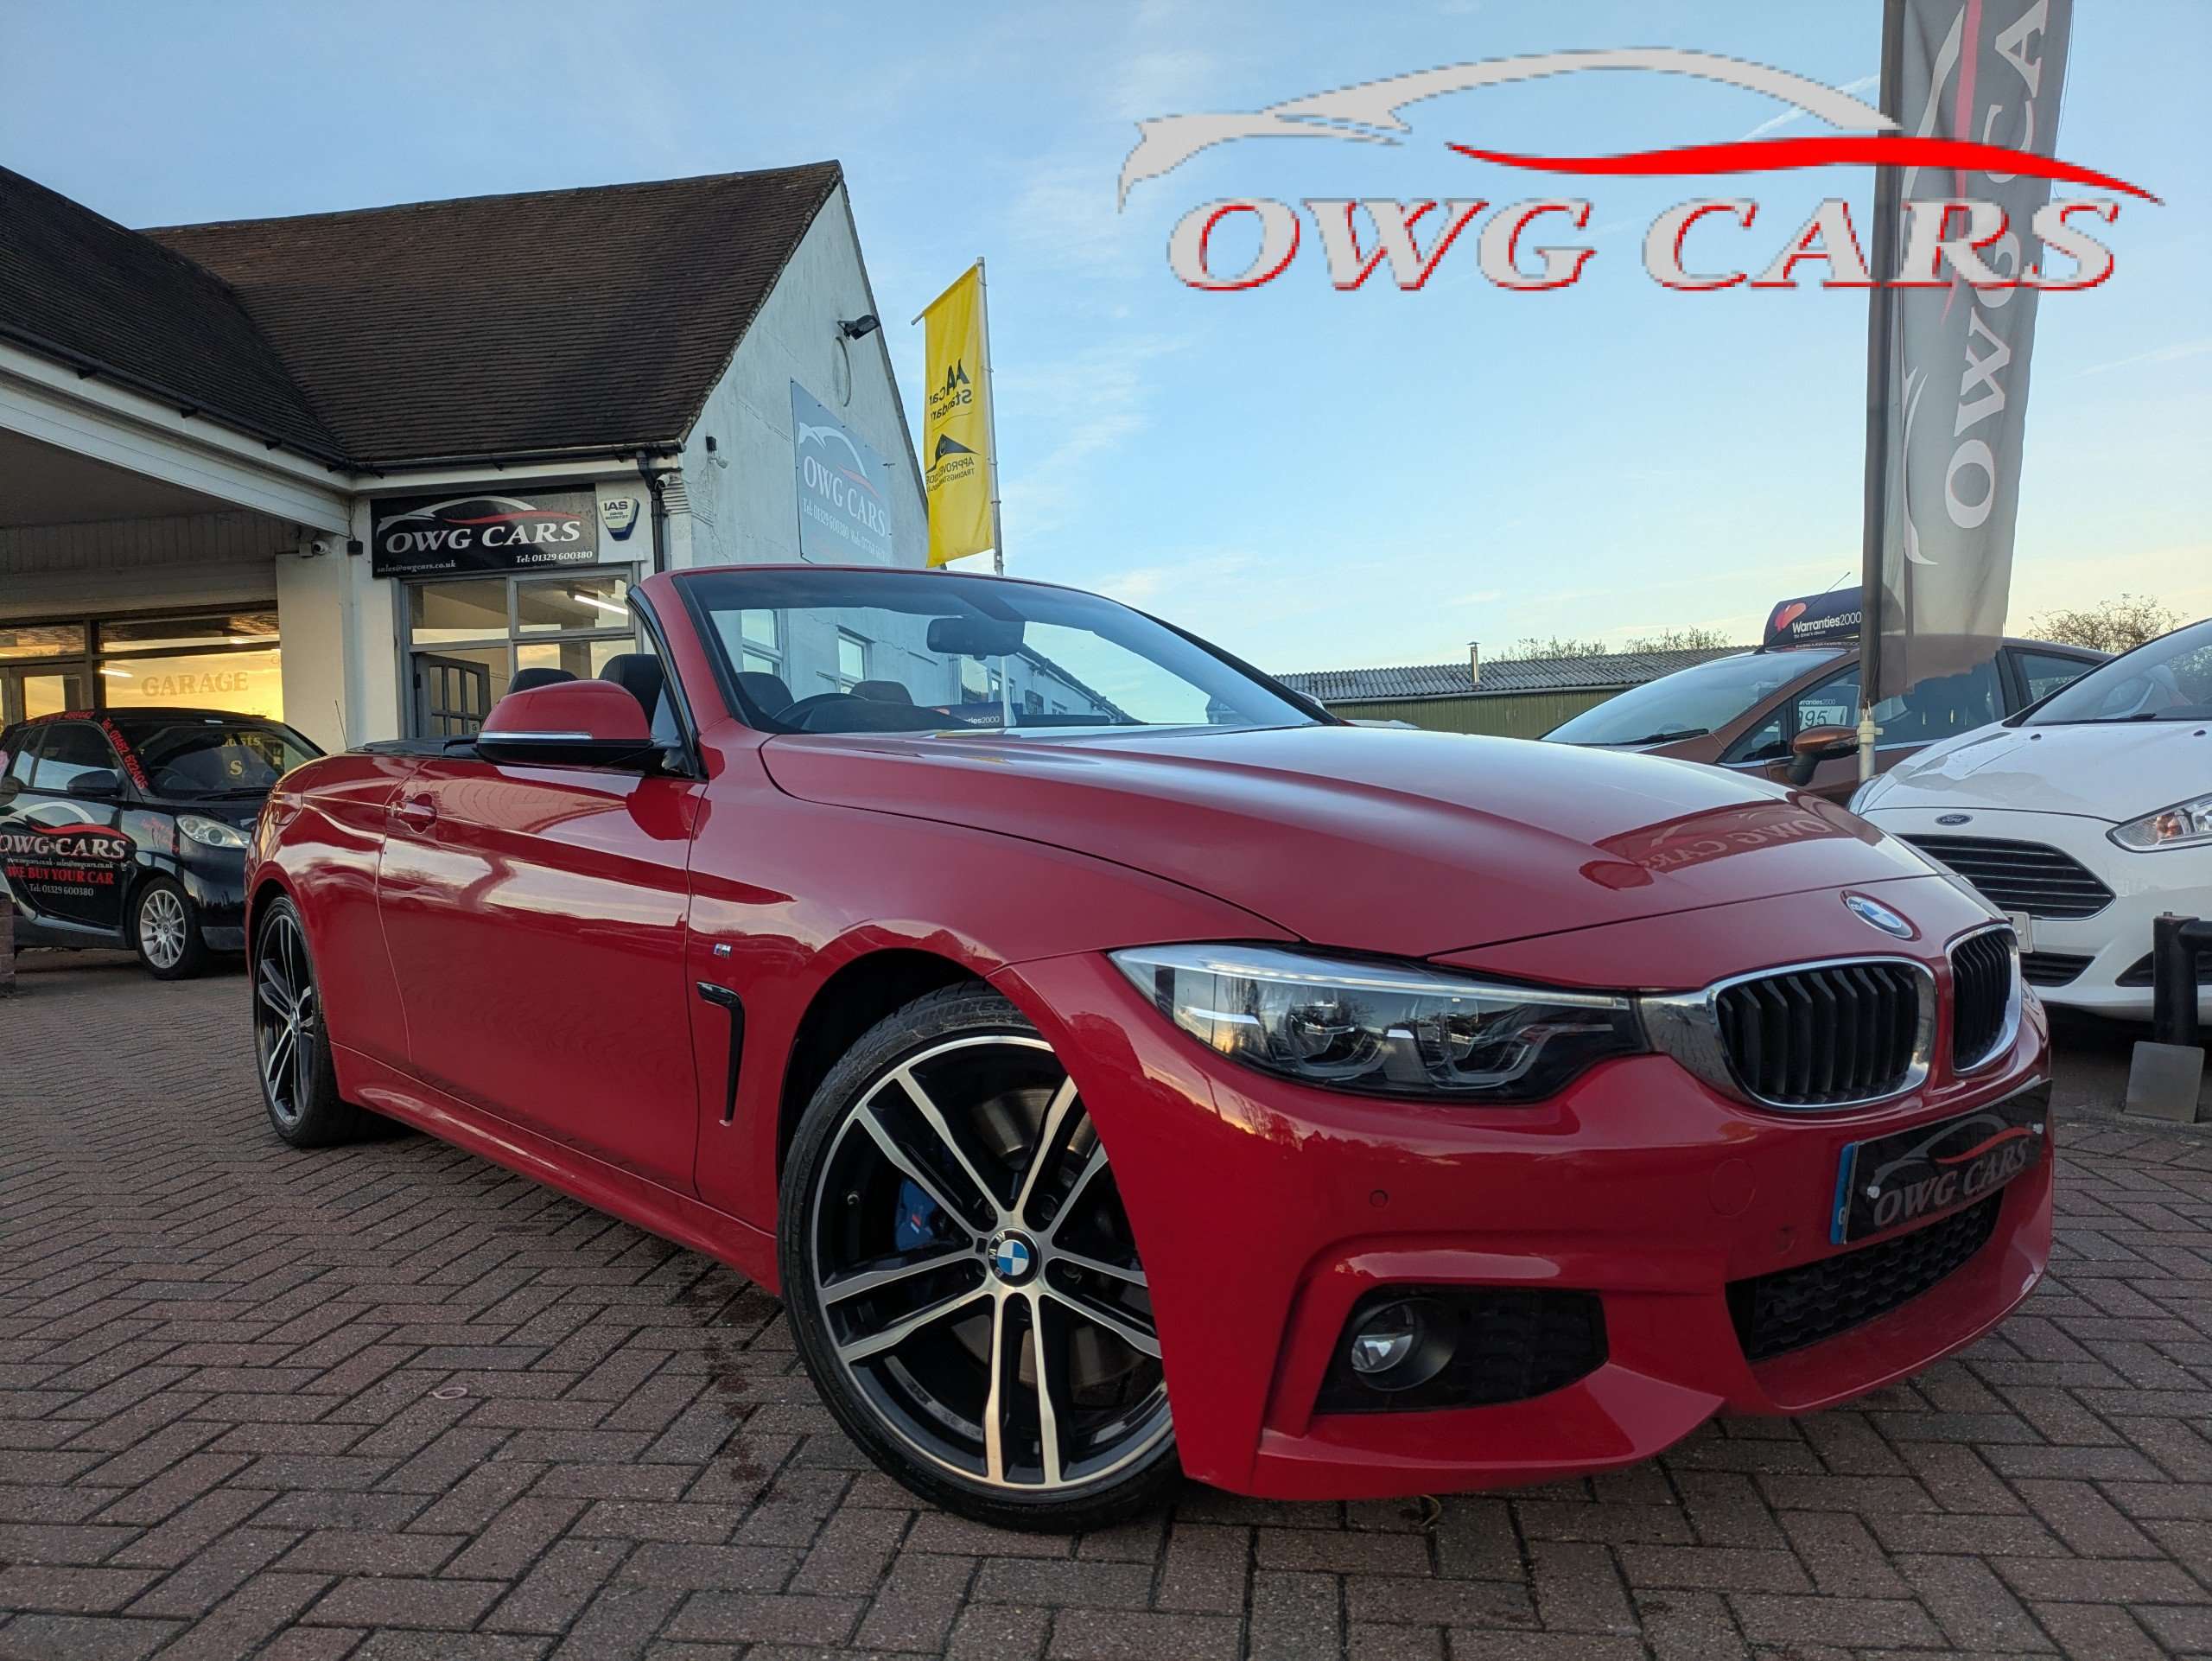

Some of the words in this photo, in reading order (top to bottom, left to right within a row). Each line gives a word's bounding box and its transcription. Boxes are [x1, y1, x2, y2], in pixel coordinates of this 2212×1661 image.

[604, 501, 628, 512] IAS
[804, 455, 842, 507] OWG
[848, 487, 886, 537] CARS
[385, 528, 473, 553] OWG
[481, 521, 581, 547] CARS
[516, 555, 531, 563] Tel:
[532, 553, 557, 563] 01329
[558, 550, 593, 561] 600380
[1792, 611, 1863, 634] Warranties2000
[141, 671, 249, 697] GARAGE
[0, 835, 49, 854] OWG
[54, 837, 126, 859] CARS
[7, 866, 27, 878] WE
[28, 867, 51, 880] BUY
[52, 869, 85, 883] YOUR
[87, 871, 115, 885] CAR
[41, 884, 63, 894] 01329
[1873, 1171, 1958, 1226] OWG
[1963, 1137, 2030, 1195] CARS
